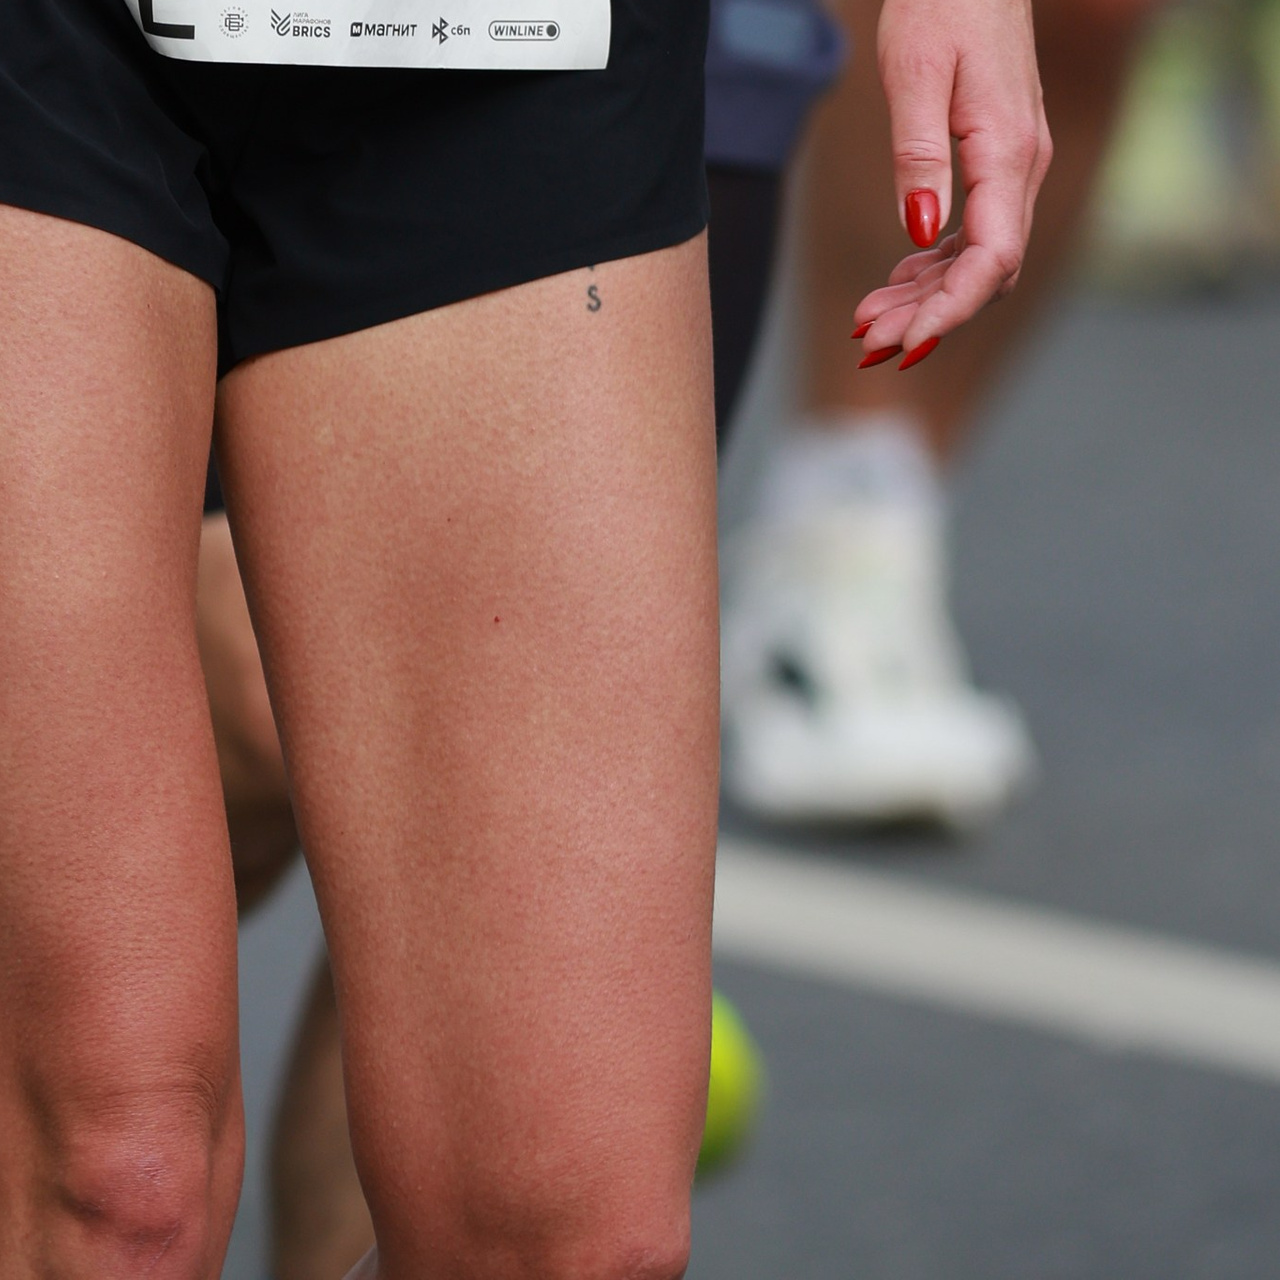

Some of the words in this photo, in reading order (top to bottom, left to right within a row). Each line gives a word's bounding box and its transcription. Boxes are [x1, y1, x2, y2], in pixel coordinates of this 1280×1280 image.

[292, 25, 331, 38] BRICS
[364, 23, 418, 37] магнит
[450, 24, 471, 36] сбп
[493, 25, 544, 37] WINLINE
